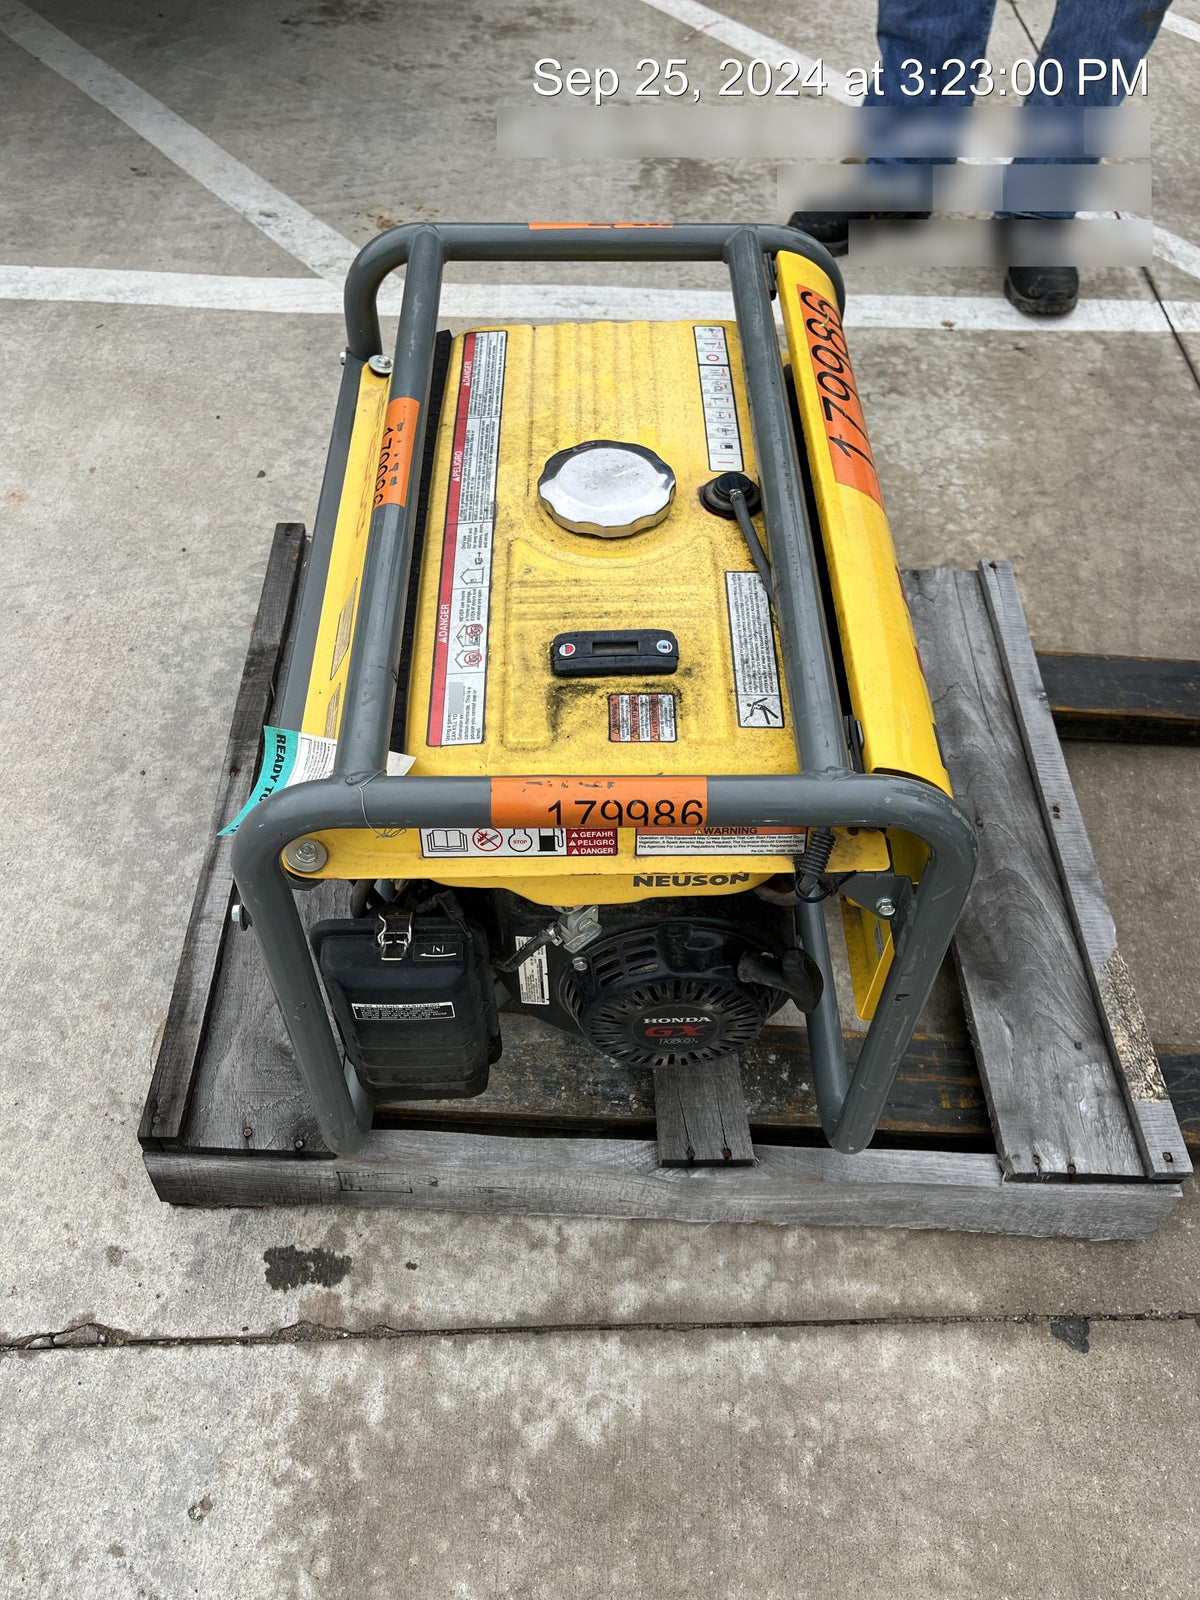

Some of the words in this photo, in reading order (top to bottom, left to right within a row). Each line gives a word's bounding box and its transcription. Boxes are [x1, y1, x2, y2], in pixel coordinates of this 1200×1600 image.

[463, 361, 472, 382] DANGER
[801, 291, 875, 471] 179986
[453, 451, 462, 477] PELIGRO
[440, 604, 449, 636] DANGER
[270, 734, 286, 783] READY
[547, 800, 703, 826] 179986
[633, 872, 750, 887] NEUSON
[645, 1024, 709, 1037] GX
